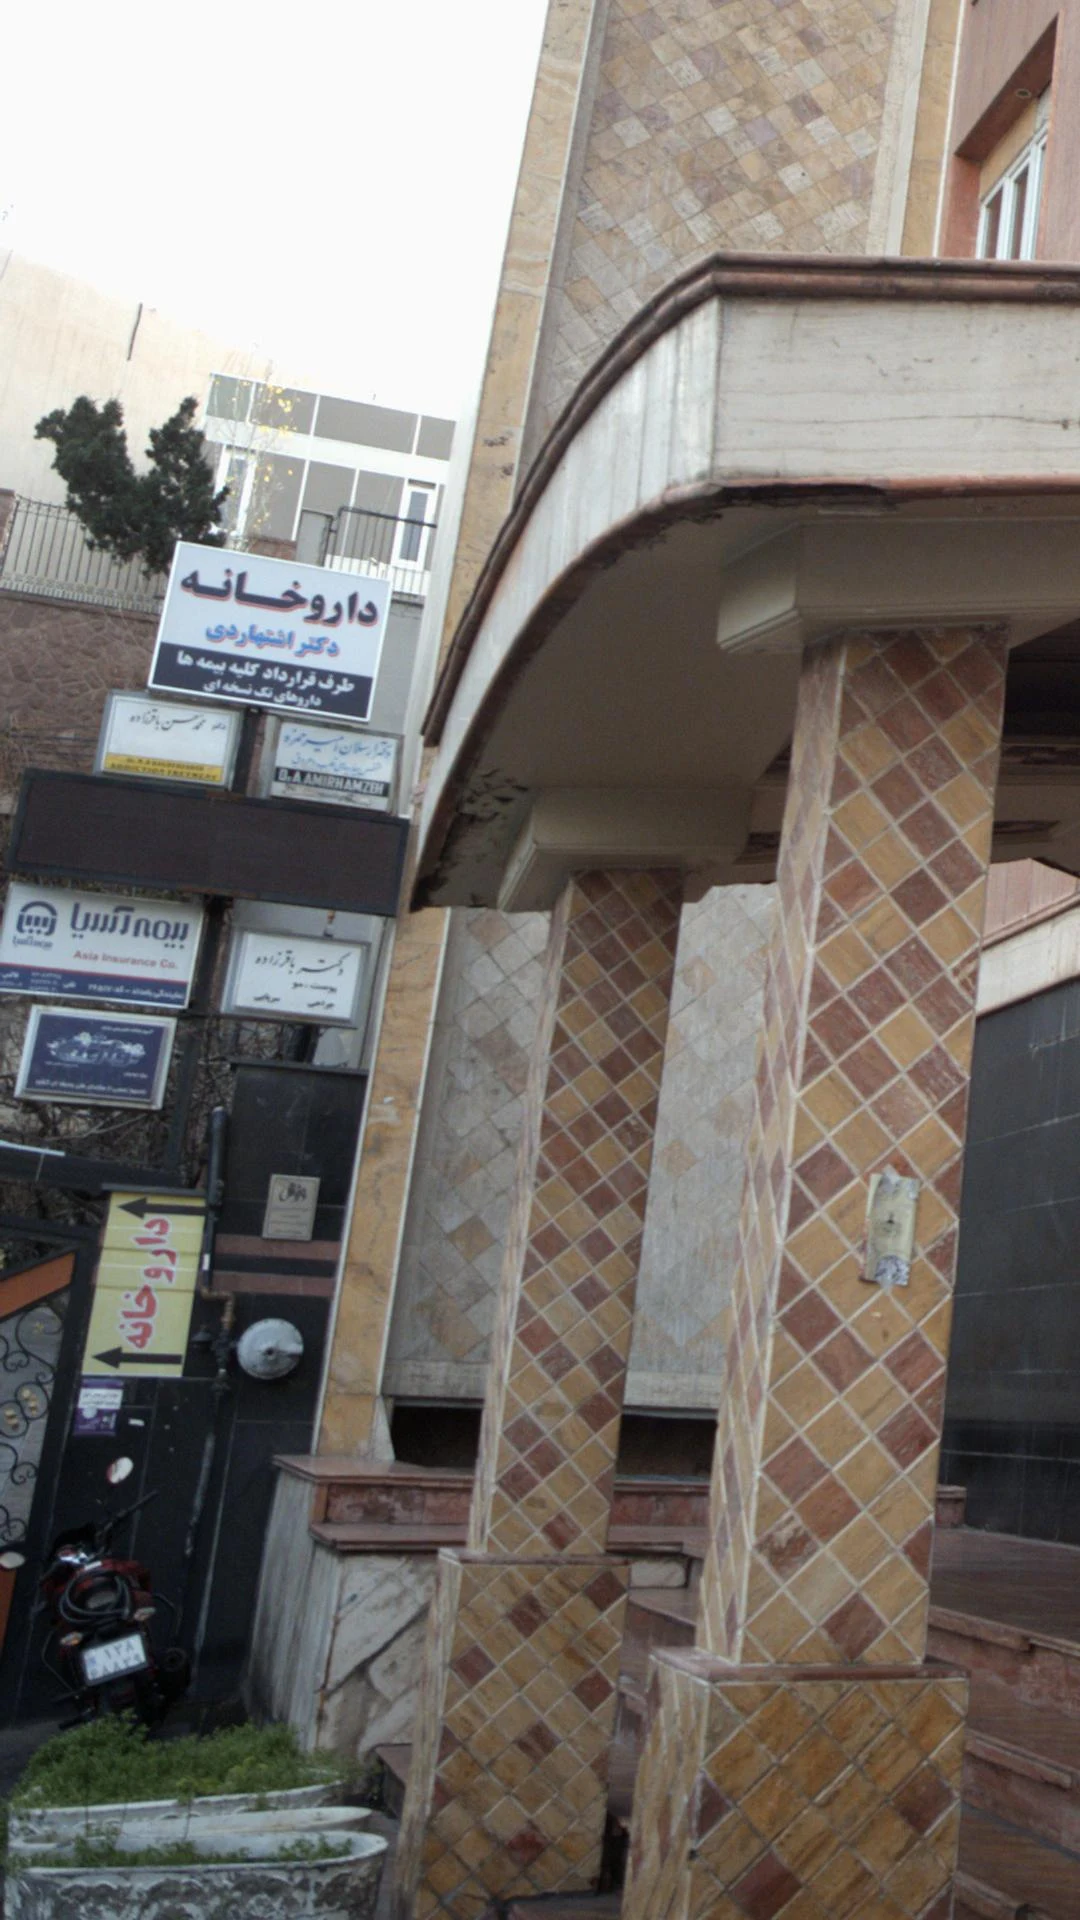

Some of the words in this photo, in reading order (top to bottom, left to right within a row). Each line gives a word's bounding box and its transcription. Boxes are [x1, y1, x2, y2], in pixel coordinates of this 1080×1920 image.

[181, 568, 378, 627] داروخانه
[205, 623, 296, 649] اشتهاردی
[294, 635, 340, 657] دکتر
[176, 650, 193, 666] ها
[196, 655, 227, 675] بیمه
[229, 662, 260, 678] کلیه
[262, 667, 316, 689] قرارداد
[203, 679, 221, 692] ای
[222, 681, 253, 696] نسخه
[254, 686, 273, 699] تک
[318, 674, 355, 695] طرف
[273, 690, 322, 707] داروهای
[70, 902, 135, 939] آسیا
[132, 917, 189, 949] بیمه
[73, 950, 99, 962] Asia
[101, 952, 157, 967] Insurance
[160, 958, 178, 969] Co.
[295, 952, 352, 976] دکتر
[119, 1217, 178, 1348] داروخانه
